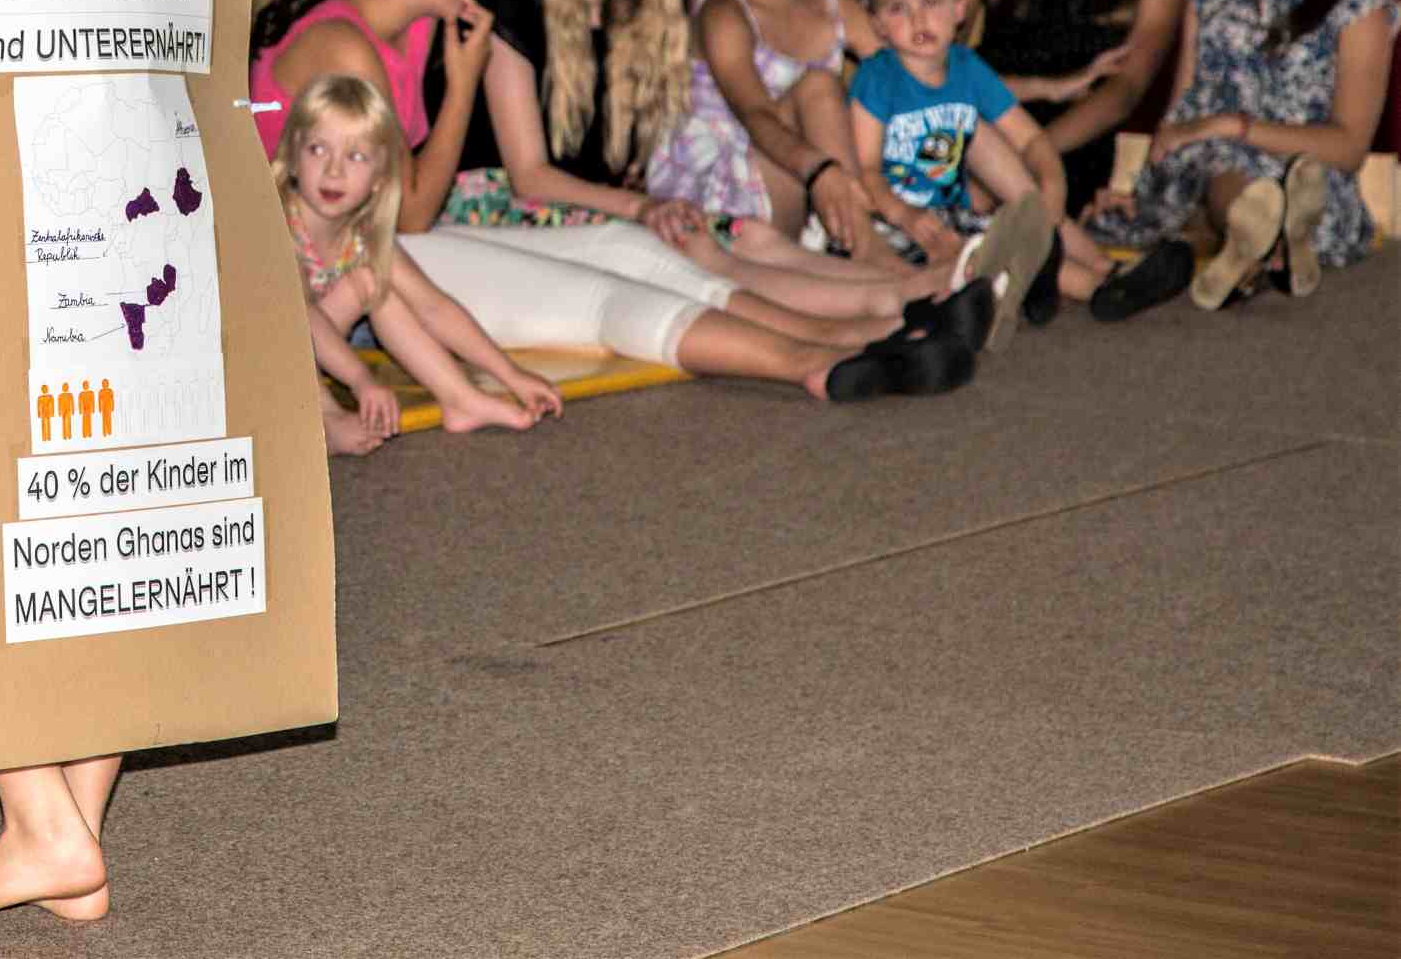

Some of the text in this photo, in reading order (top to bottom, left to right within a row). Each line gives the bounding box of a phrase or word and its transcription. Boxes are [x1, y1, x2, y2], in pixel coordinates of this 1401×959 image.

[27, 470, 59, 501] 40
[99, 464, 139, 496] der
[147, 456, 217, 491] Kinder
[224, 452, 247, 483] im
[13, 513, 255, 568] Norden Ghanas sind
